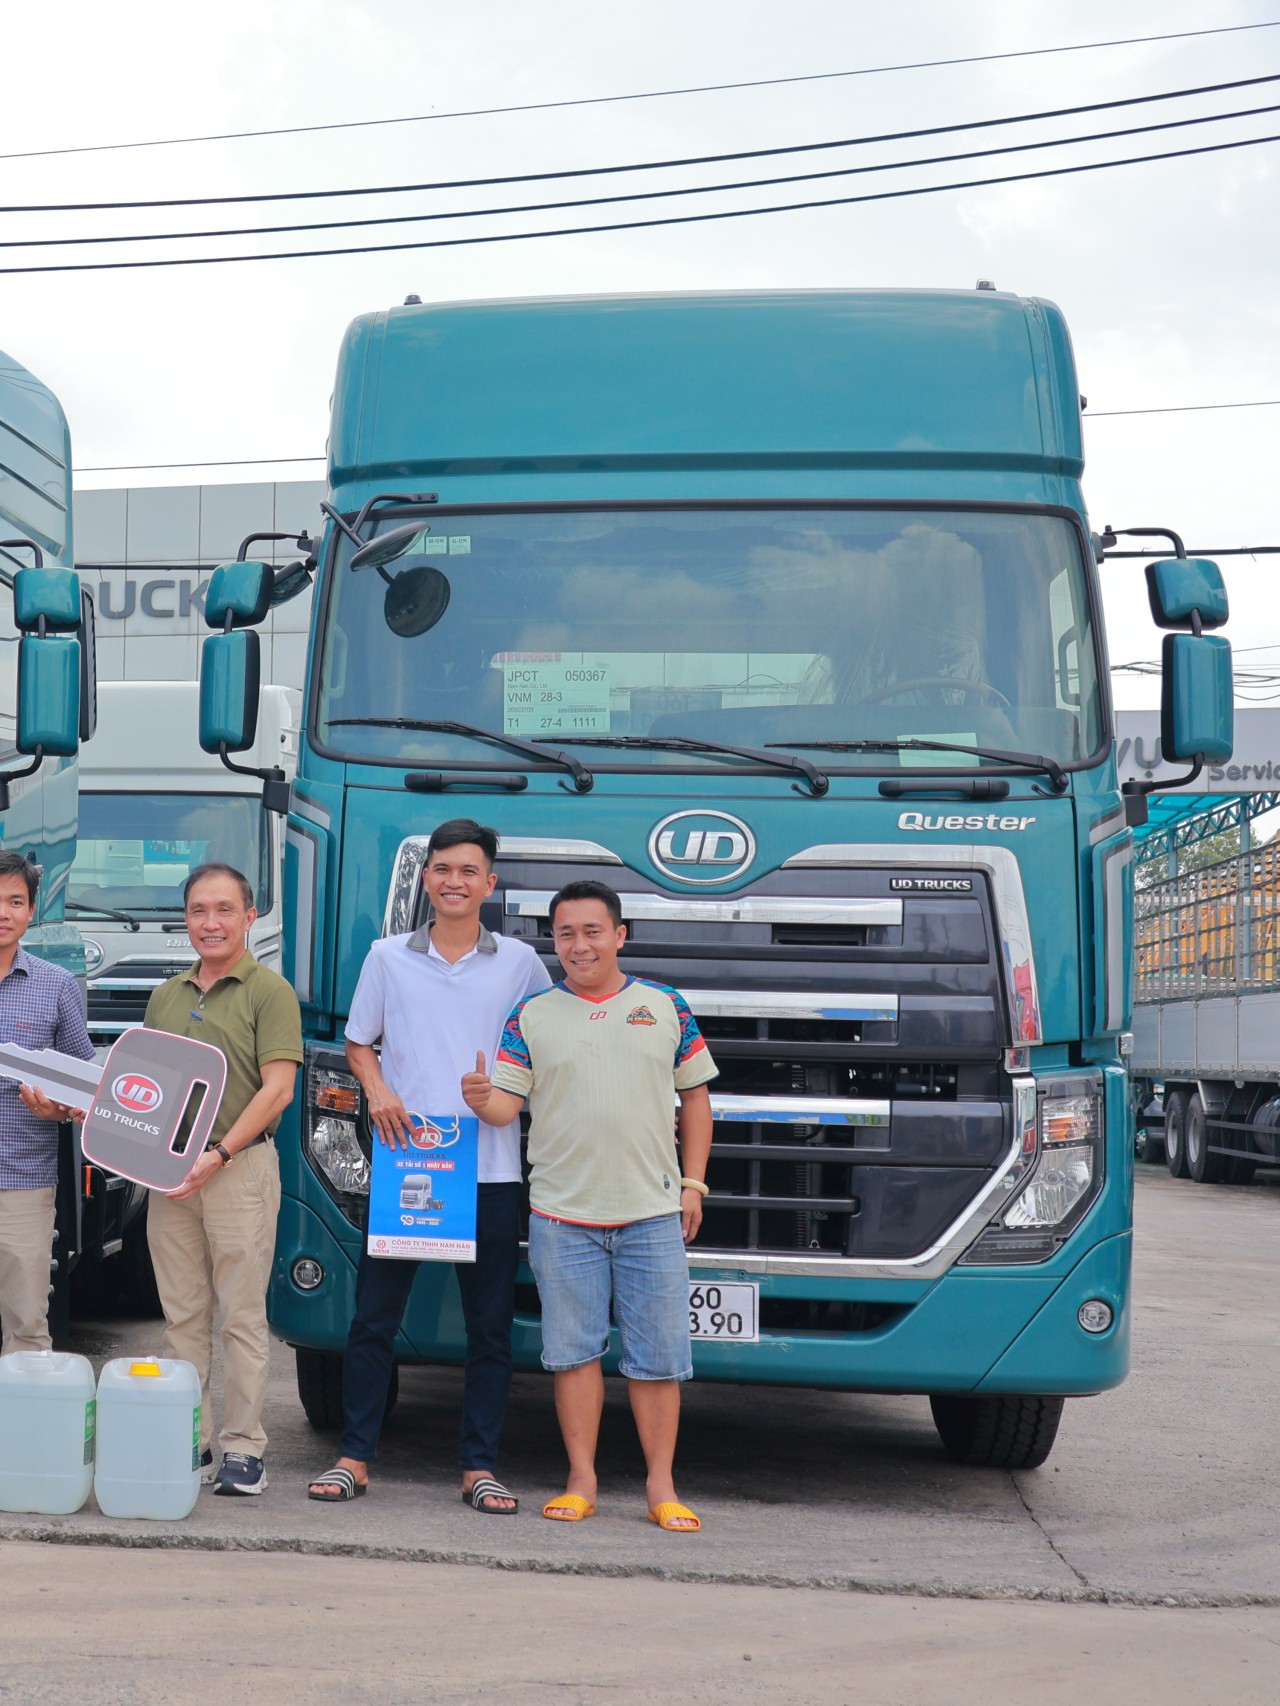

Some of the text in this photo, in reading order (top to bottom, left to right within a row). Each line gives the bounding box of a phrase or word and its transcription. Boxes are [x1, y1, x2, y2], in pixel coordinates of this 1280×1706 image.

[508, 670, 606, 682] JPCT 050367
[508, 692, 562, 702] VNM 28-3
[507, 718, 596, 728] T1 27-4 1111
[898, 812, 1036, 832] Quester
[658, 830, 746, 864] UD
[892, 879, 971, 890] UD TRUCKS
[94, 1106, 160, 1136] UD TRUCKS
[392, 1238, 412, 1246] CÔNG
